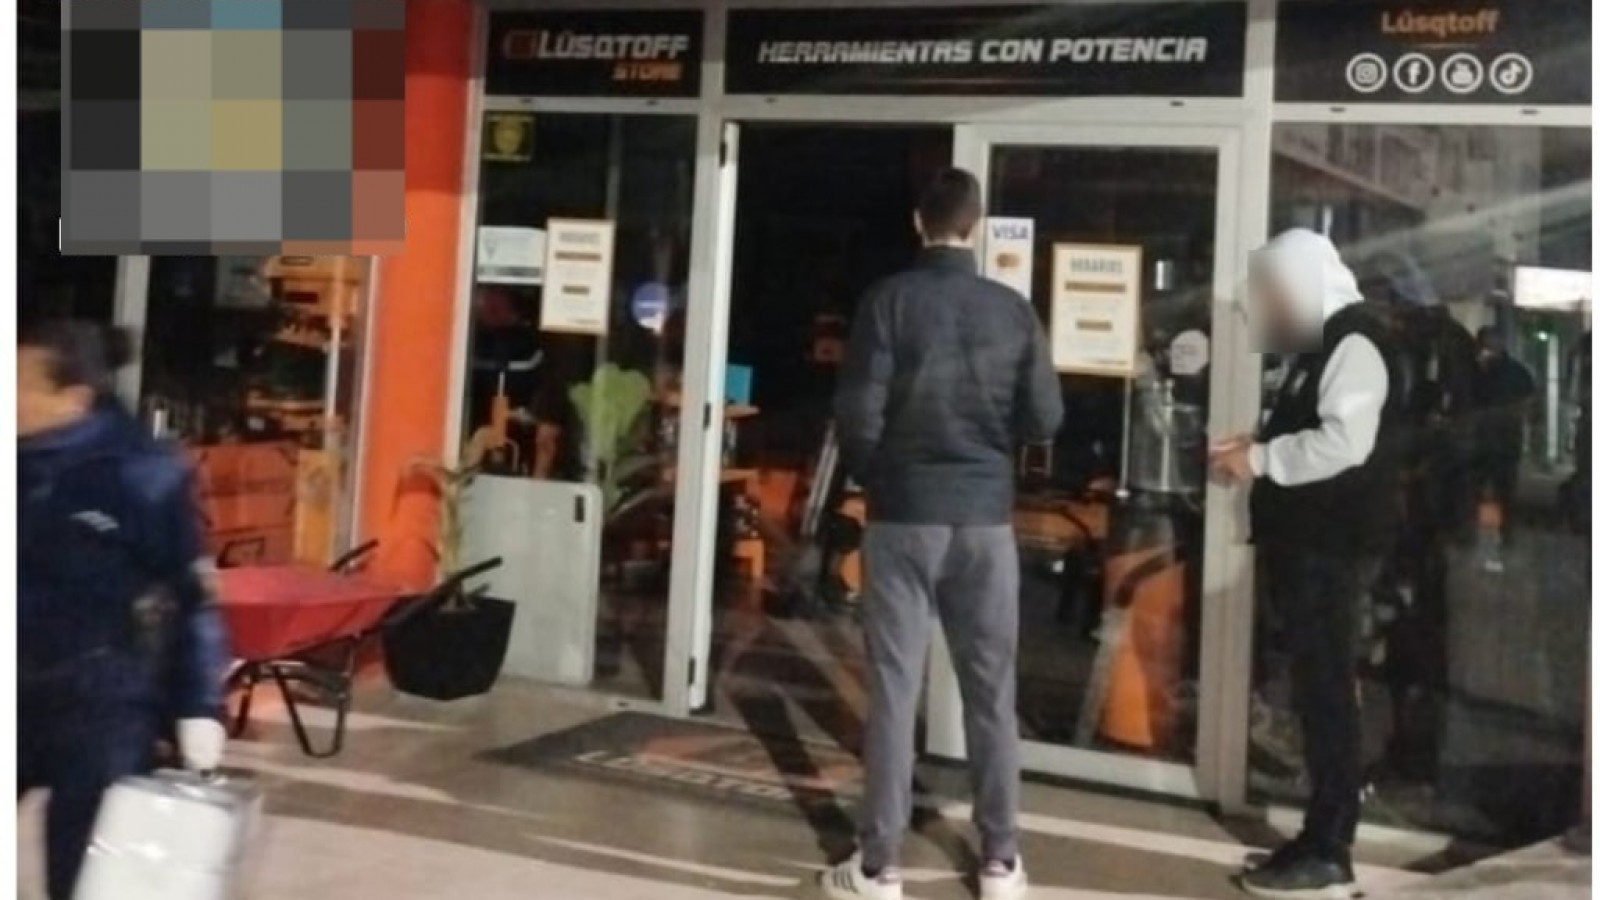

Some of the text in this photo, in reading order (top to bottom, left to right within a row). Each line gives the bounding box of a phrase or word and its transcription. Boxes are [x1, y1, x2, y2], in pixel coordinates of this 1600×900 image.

[758, 37, 1208, 64] HERRAMIENTAS CON POTENCIA
[613, 63, 683, 80] STORE
[993, 226, 1028, 240] VISA
